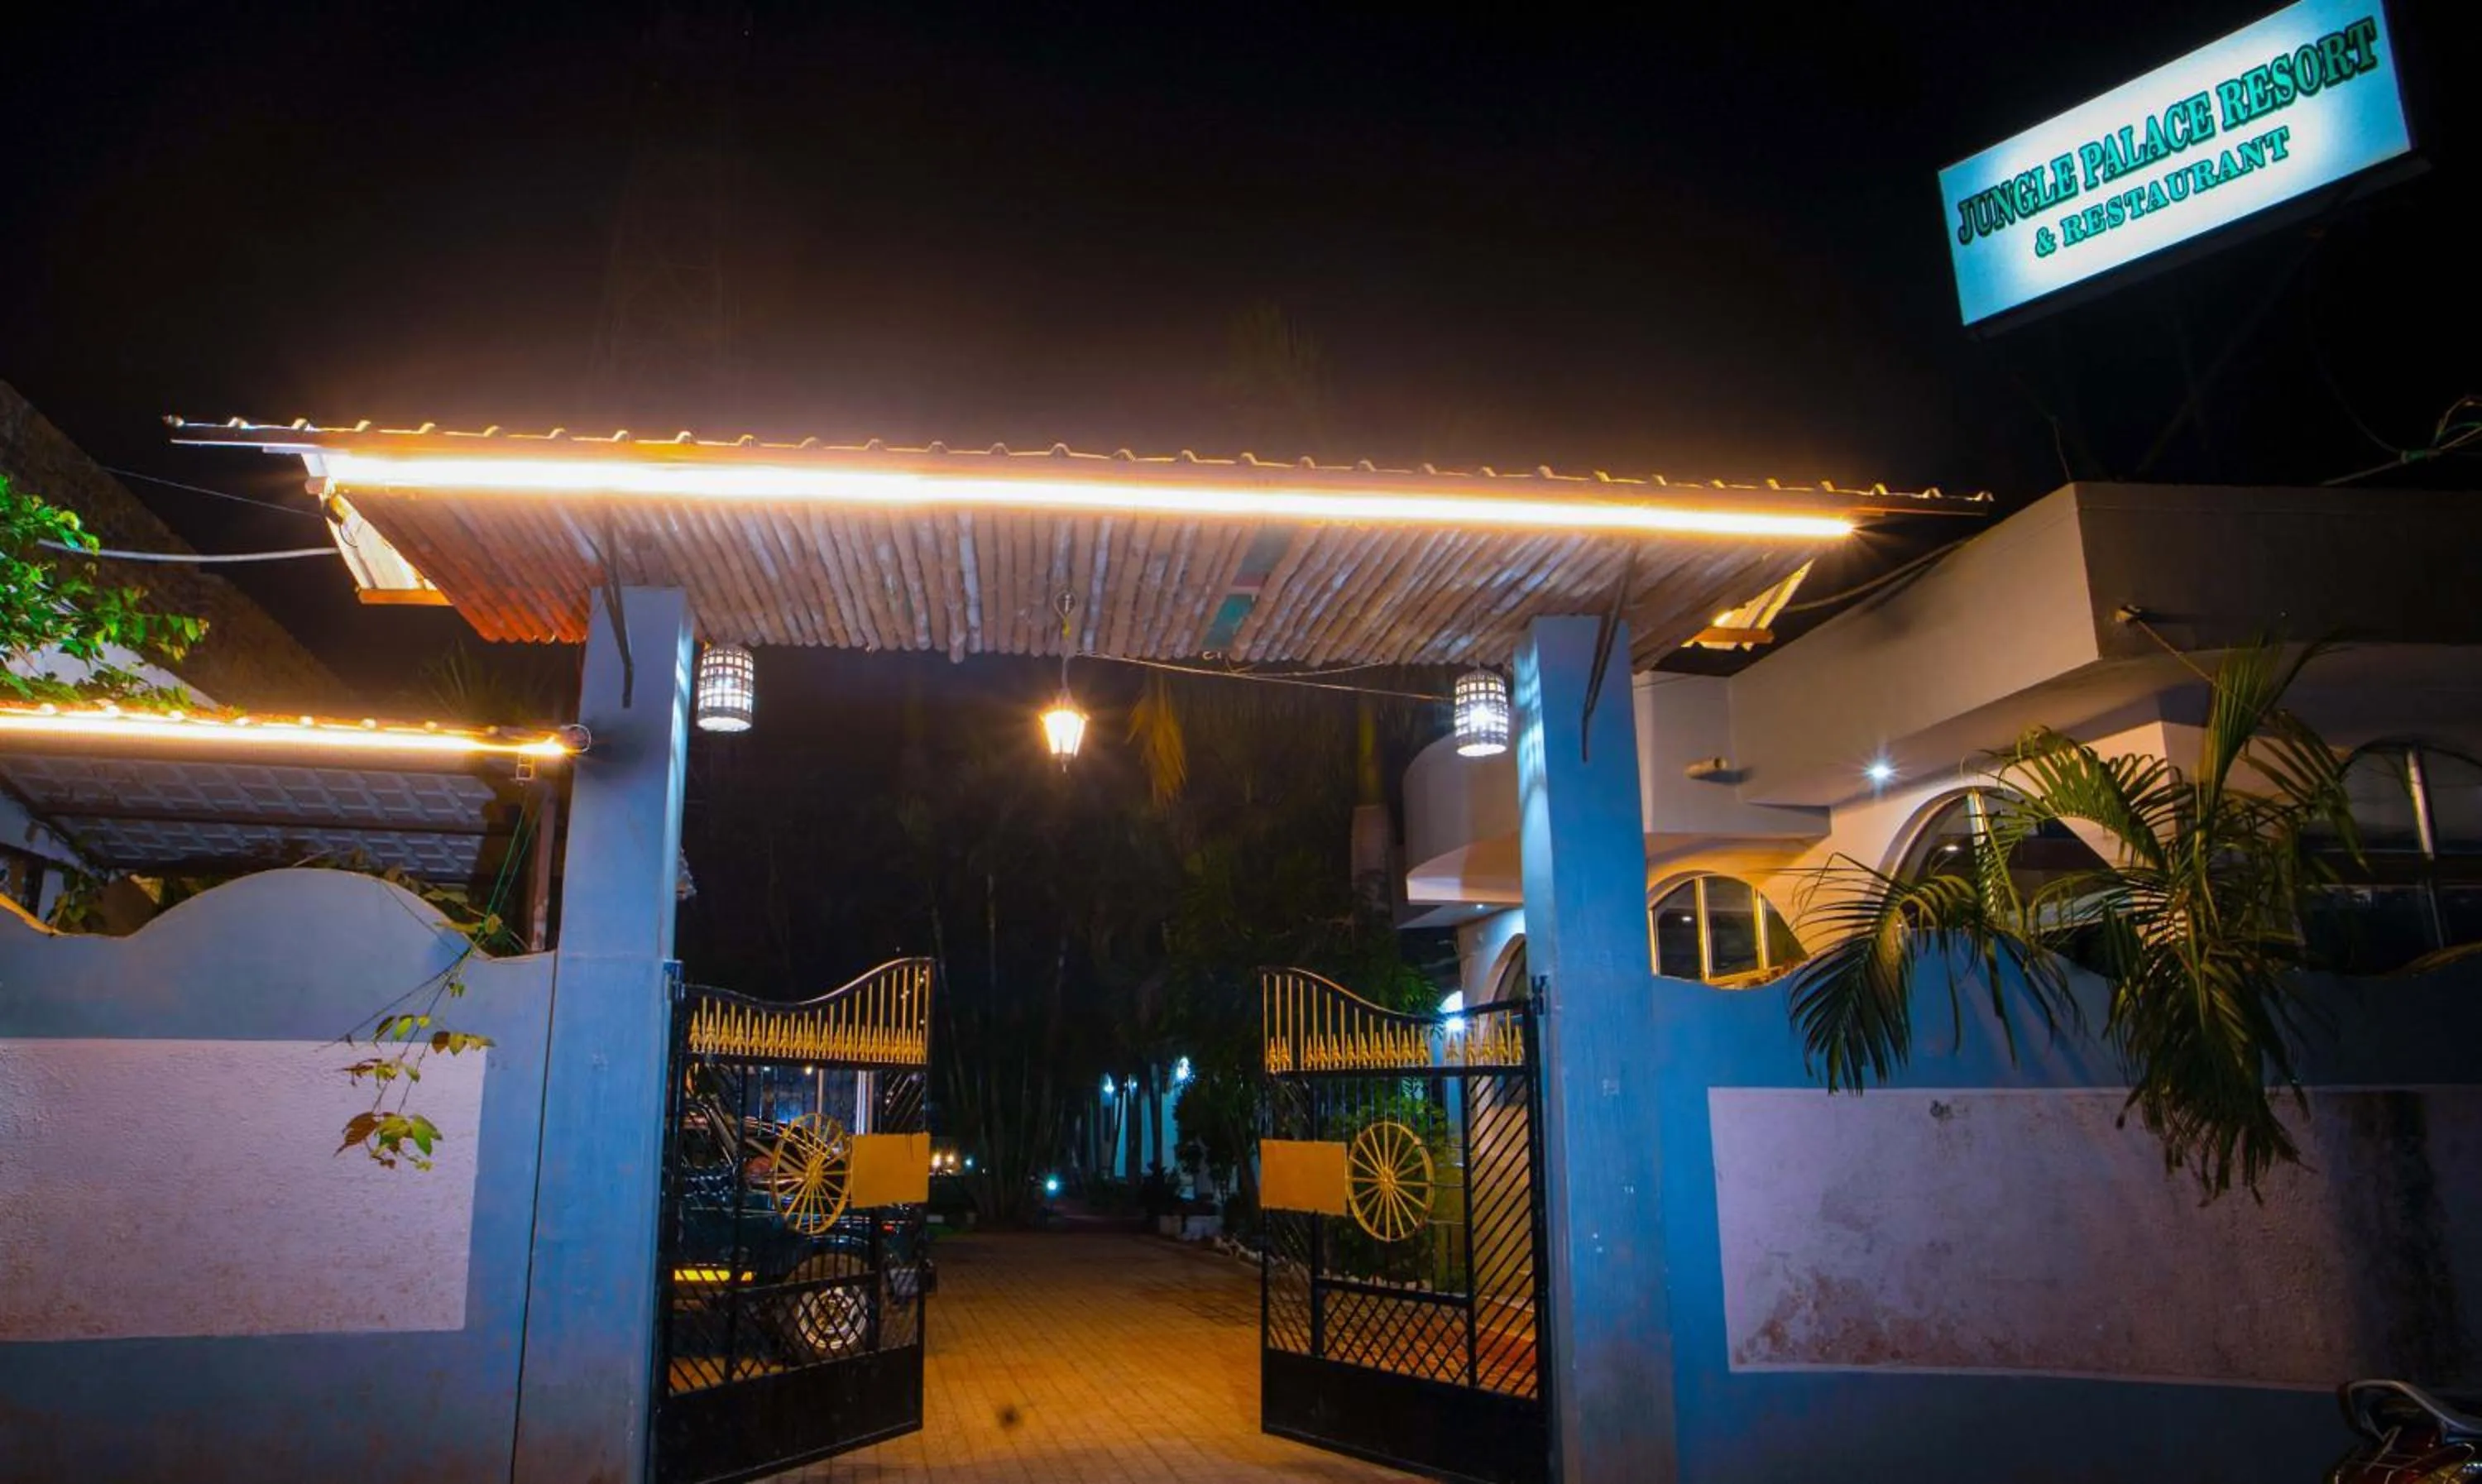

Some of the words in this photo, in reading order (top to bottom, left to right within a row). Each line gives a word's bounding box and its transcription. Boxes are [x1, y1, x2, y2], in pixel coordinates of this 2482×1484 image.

[1957, 153, 2085, 244] JUNGLE
[2080, 91, 2216, 190] PALACE
[2217, 16, 2377, 131] RESORT
[2034, 227, 2056, 257] &
[2061, 127, 2290, 247] RESTAURANT
